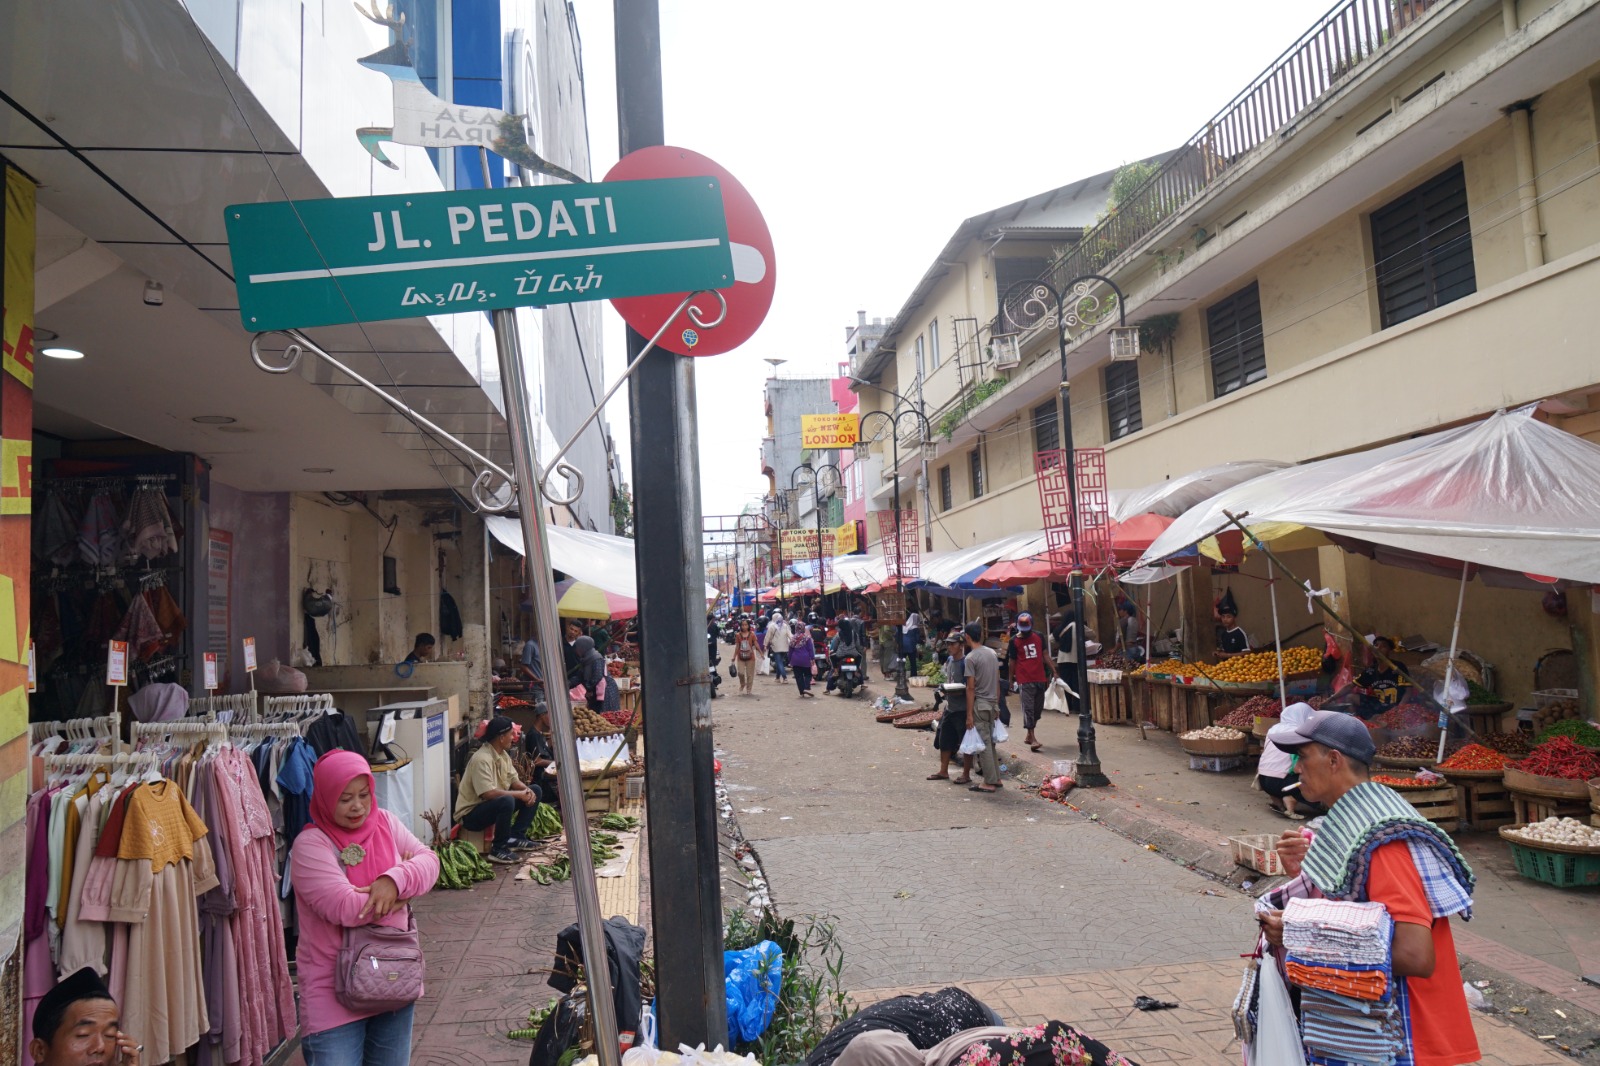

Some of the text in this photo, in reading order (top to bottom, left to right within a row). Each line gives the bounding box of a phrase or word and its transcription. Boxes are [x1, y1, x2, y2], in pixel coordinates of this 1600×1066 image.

[367, 196, 618, 252] JL. PEDATI
[804, 434, 857, 445] LONDON
[1023, 643, 1037, 659] 15
